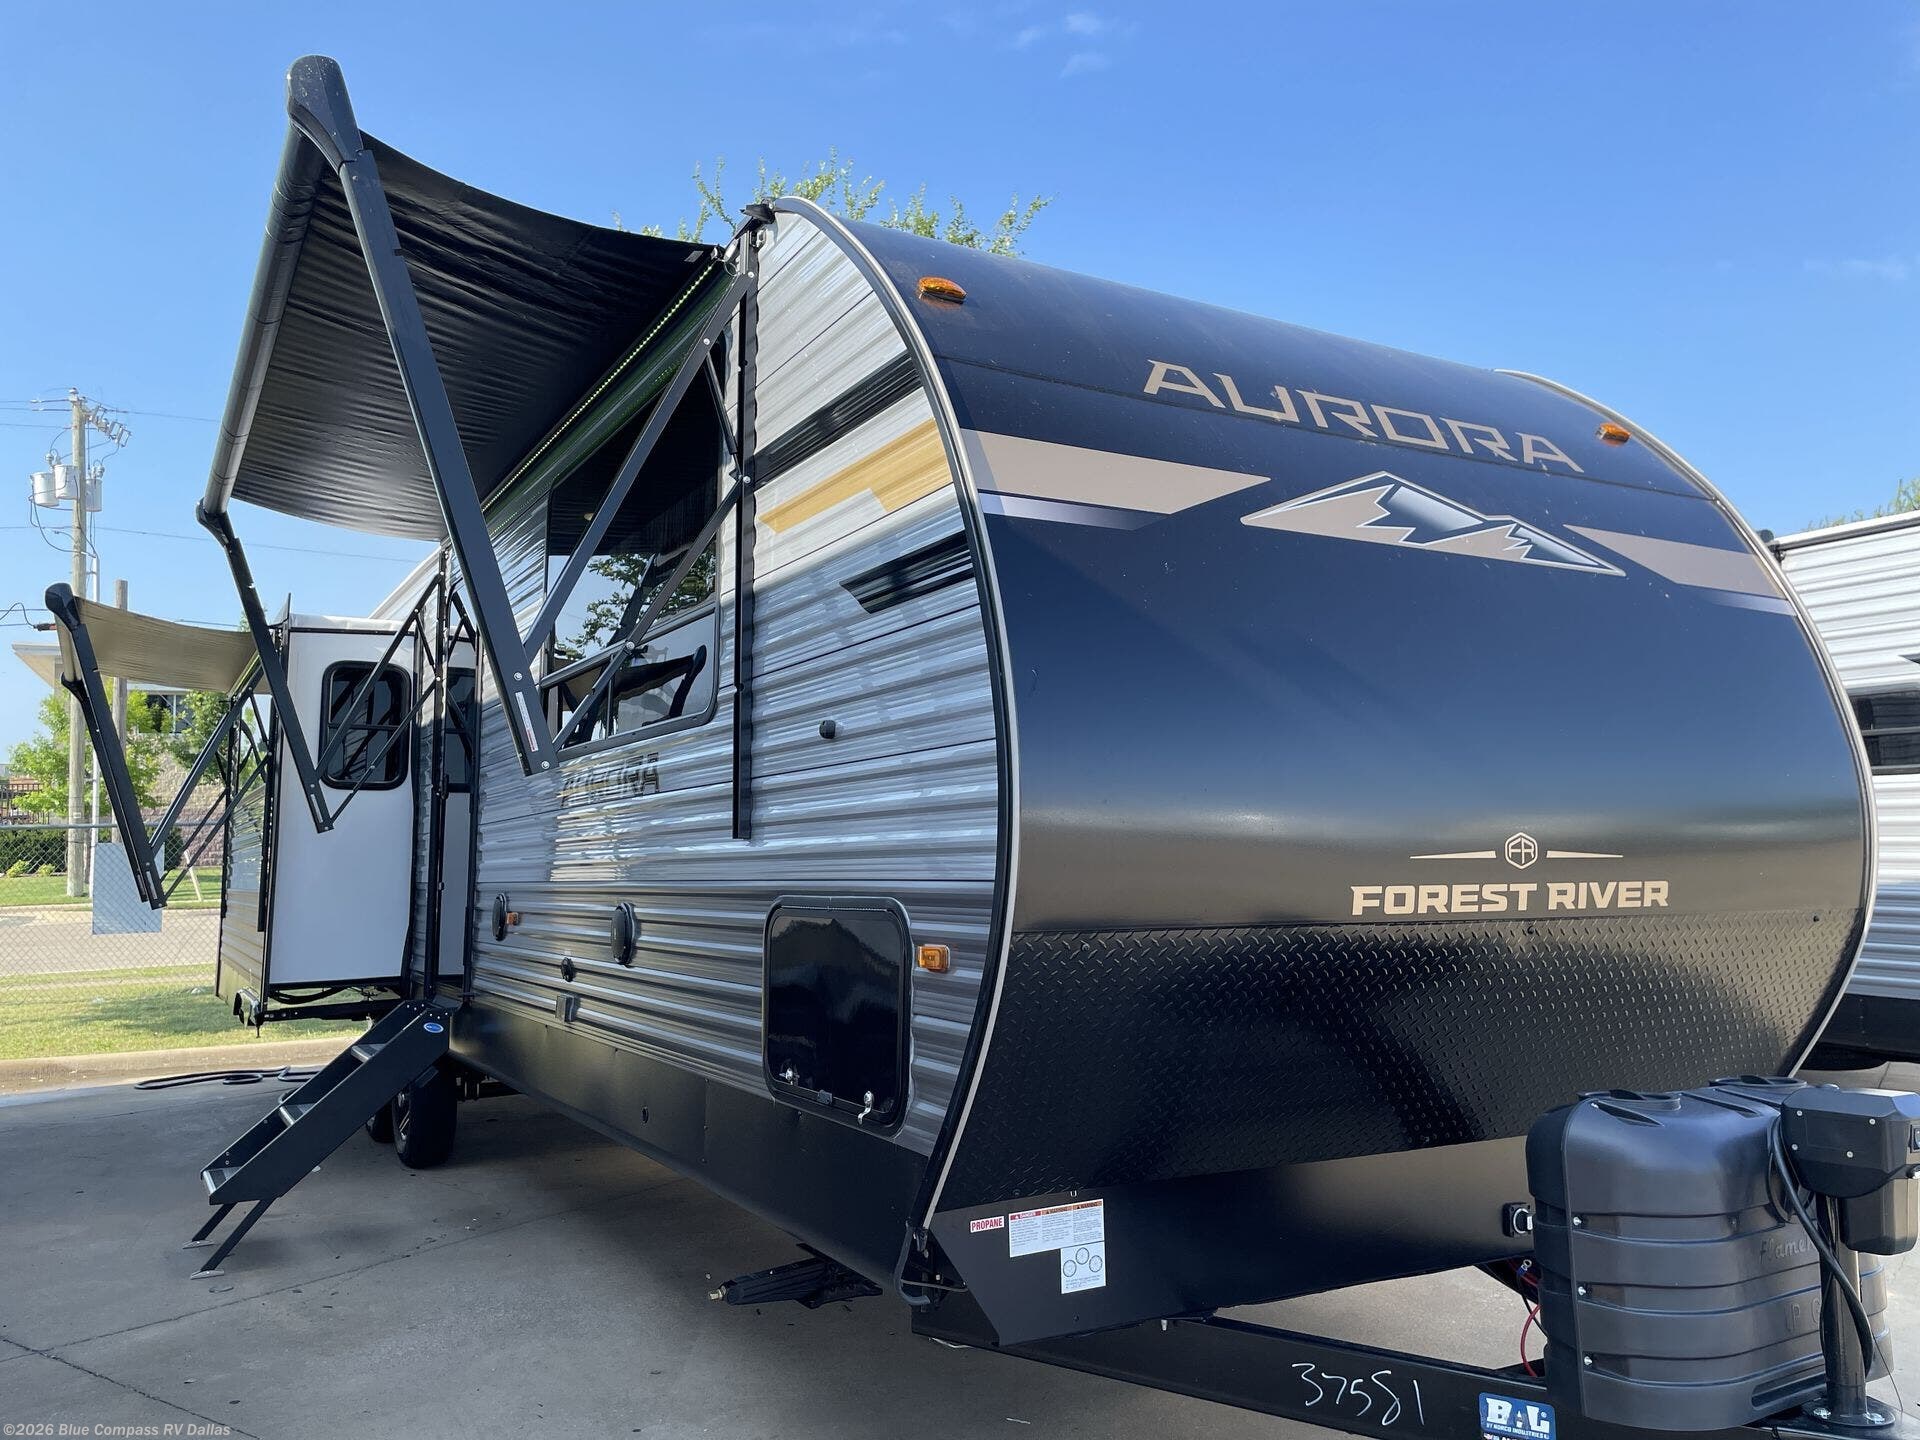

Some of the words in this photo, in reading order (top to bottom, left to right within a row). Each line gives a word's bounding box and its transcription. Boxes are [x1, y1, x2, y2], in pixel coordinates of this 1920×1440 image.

[1143, 359, 1585, 473] AURORA
[1350, 882, 1538, 916] FOREST
[1547, 880, 1669, 911] RIVER
[971, 1218, 1003, 1231] PROPANE
